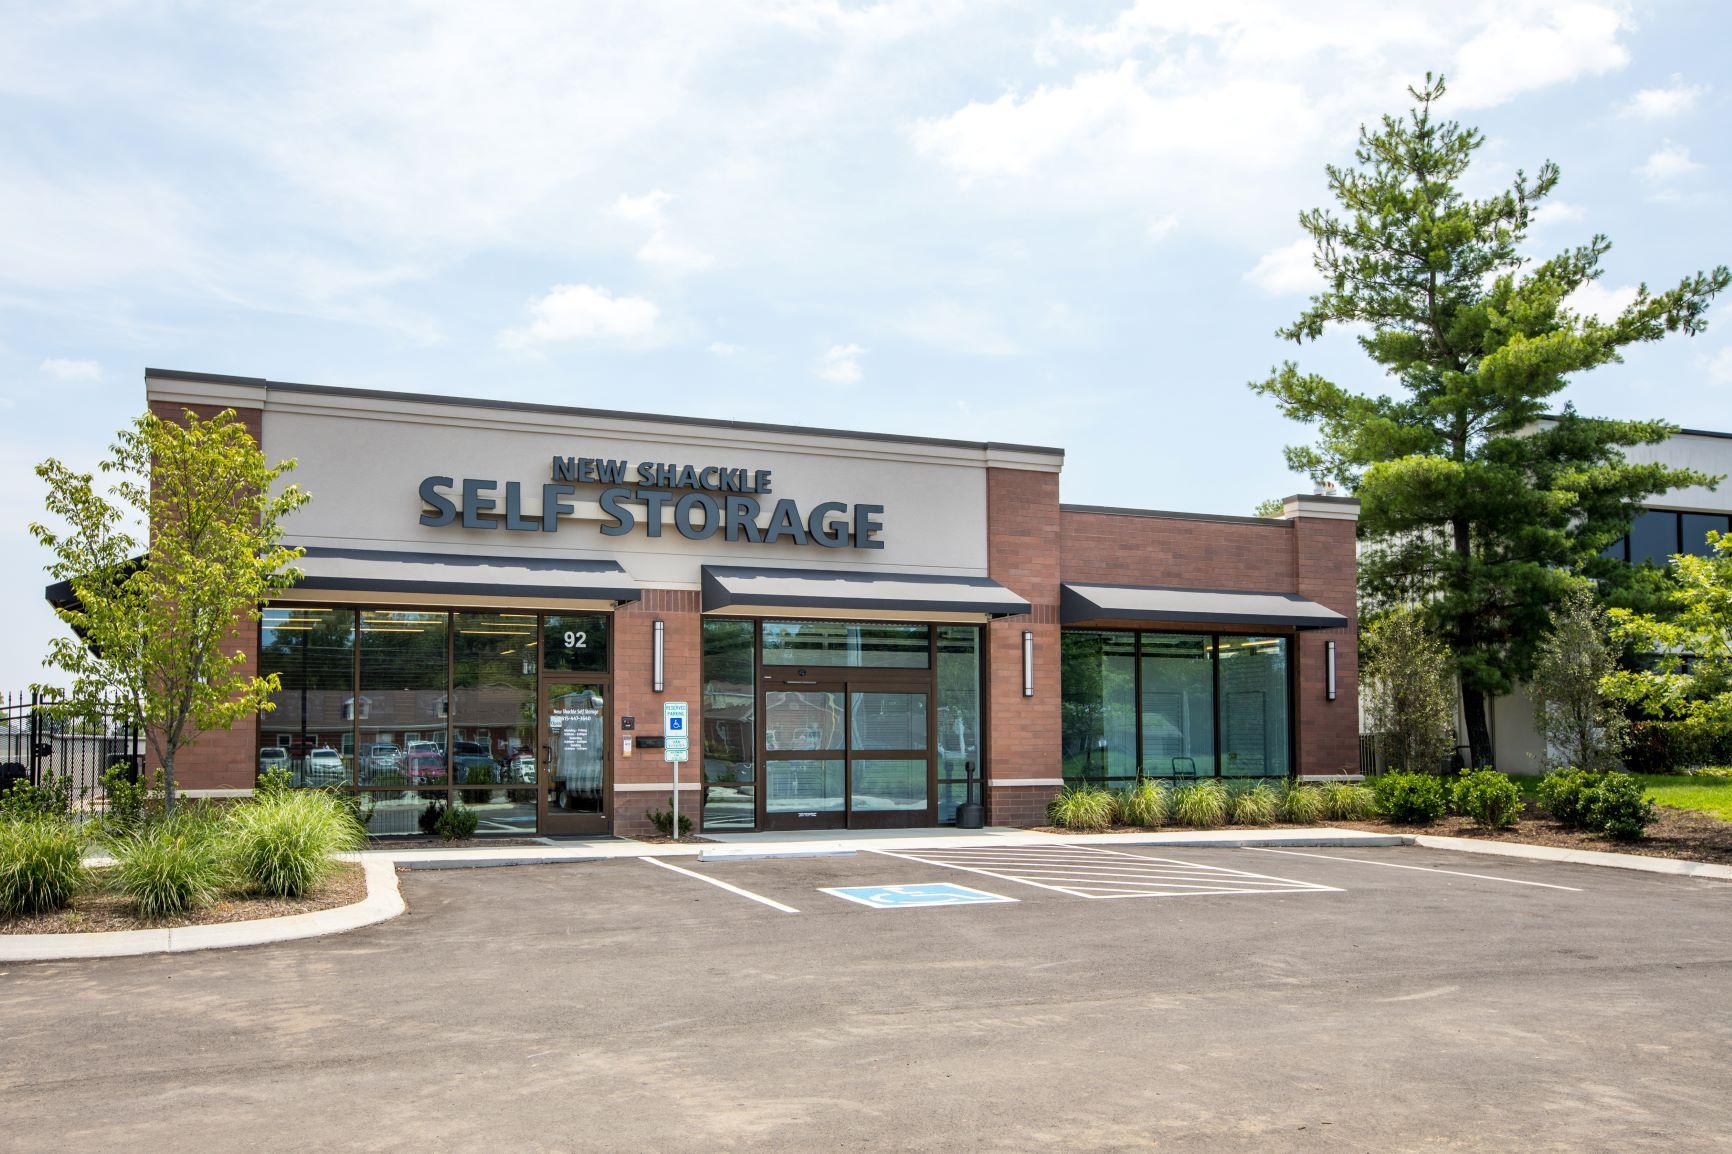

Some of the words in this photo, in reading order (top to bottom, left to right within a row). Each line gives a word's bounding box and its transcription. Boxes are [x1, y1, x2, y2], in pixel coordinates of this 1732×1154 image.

[553, 456, 628, 485] NEW
[637, 461, 772, 494] SHACKLE
[418, 475, 575, 532] SELF
[599, 488, 885, 549] STORAGE
[564, 631, 587, 648] 92
